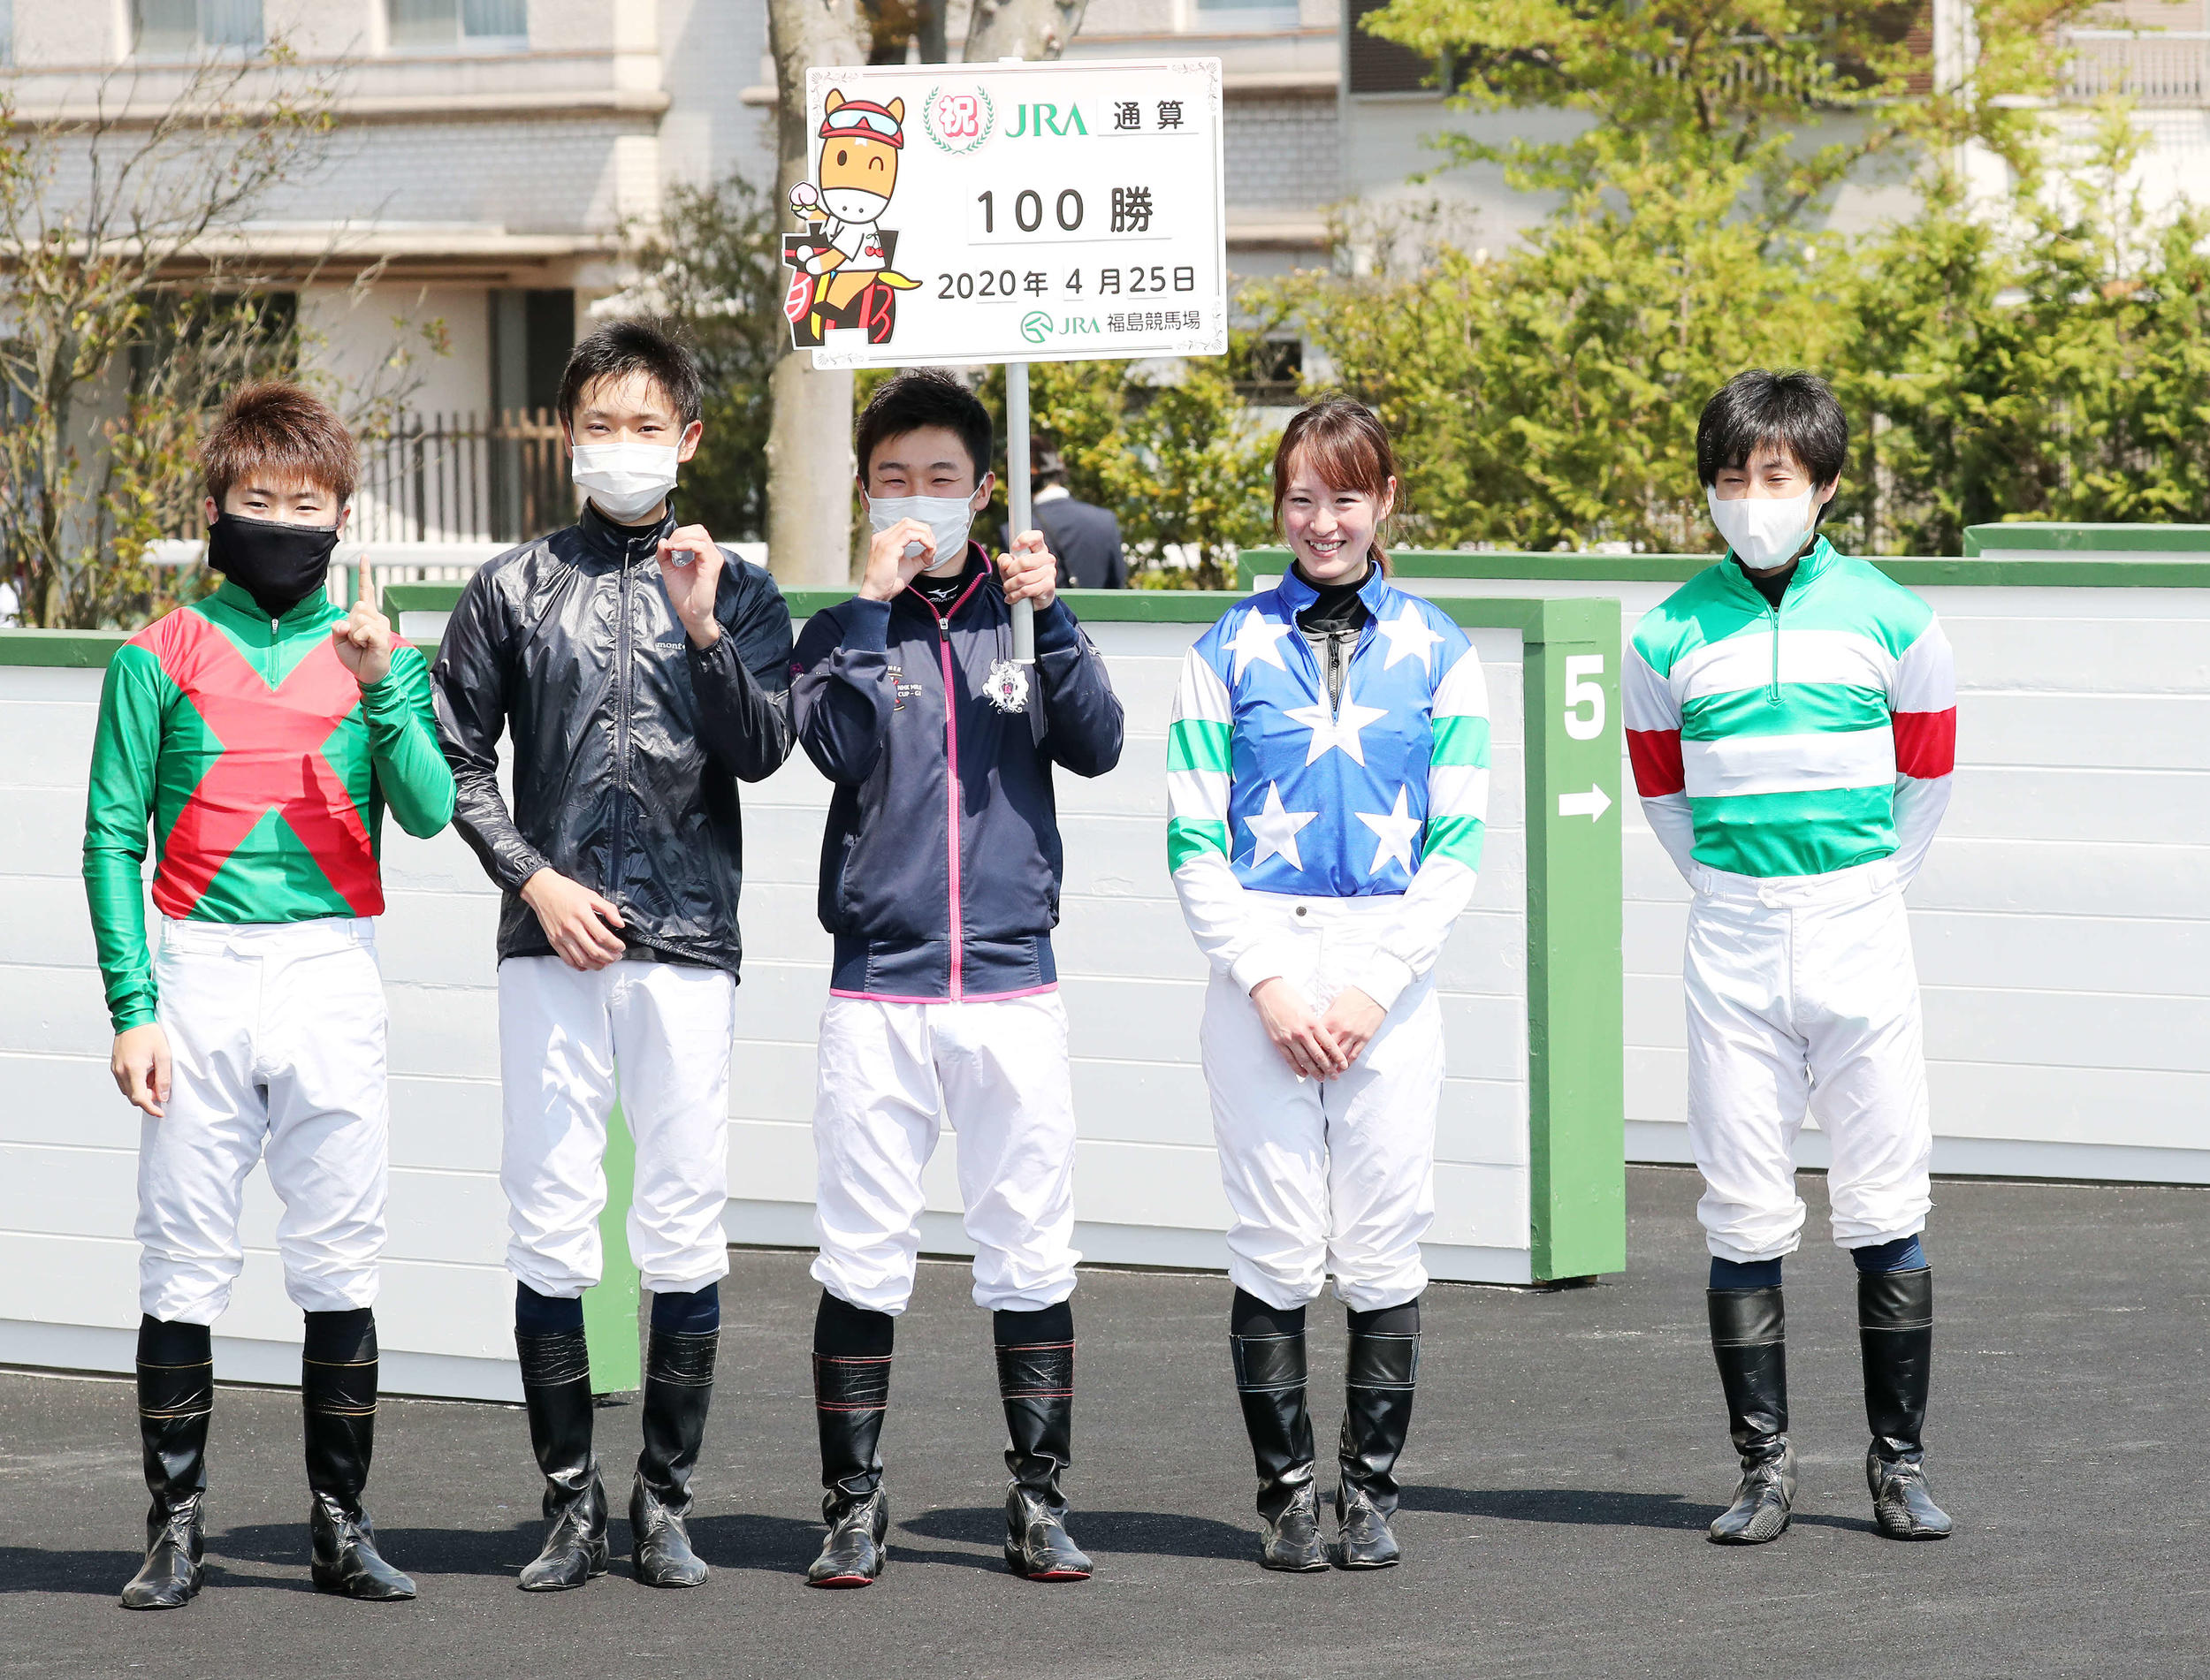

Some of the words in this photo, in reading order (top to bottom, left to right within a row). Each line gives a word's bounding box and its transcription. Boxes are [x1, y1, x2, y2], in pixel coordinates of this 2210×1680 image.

[939, 95, 979, 137] 祝
[1005, 102, 1089, 138] JRA
[1114, 100, 1184, 130] 通算
[1059, 316, 1101, 335] JRA
[1107, 310, 1200, 332] 福島競馬場
[1564, 654, 1605, 741] 5
